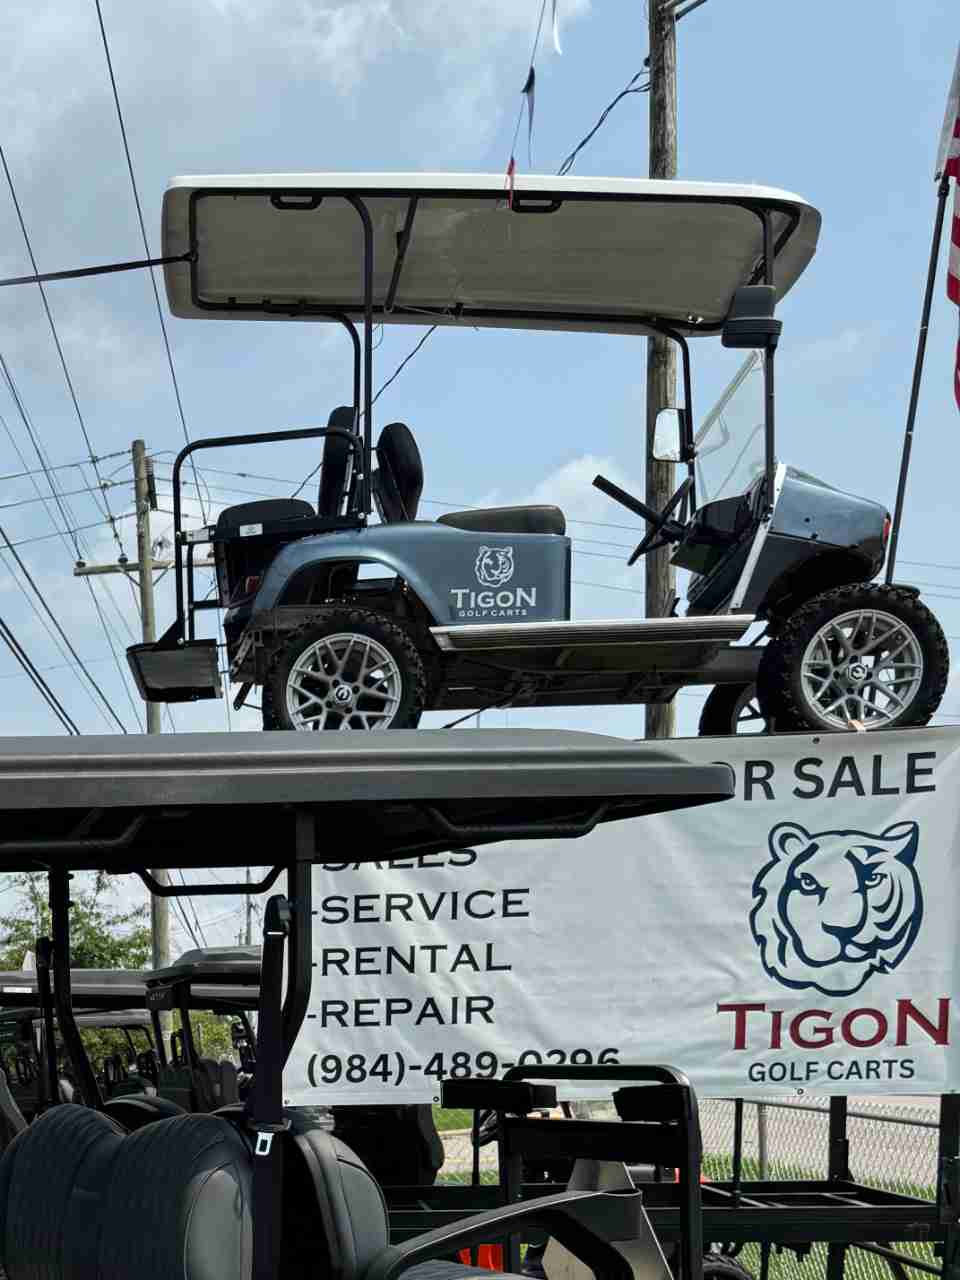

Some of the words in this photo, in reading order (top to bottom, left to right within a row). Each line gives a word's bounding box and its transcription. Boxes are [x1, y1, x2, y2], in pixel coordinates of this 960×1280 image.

[450, 587, 537, 609] TIGON
[792, 751, 937, 799] SALE
[307, 996, 495, 1027] -REPAIR
[716, 998, 951, 1050] TIGON
[748, 1061, 819, 1082] GOLF
[827, 1059, 915, 1081] CARTS
